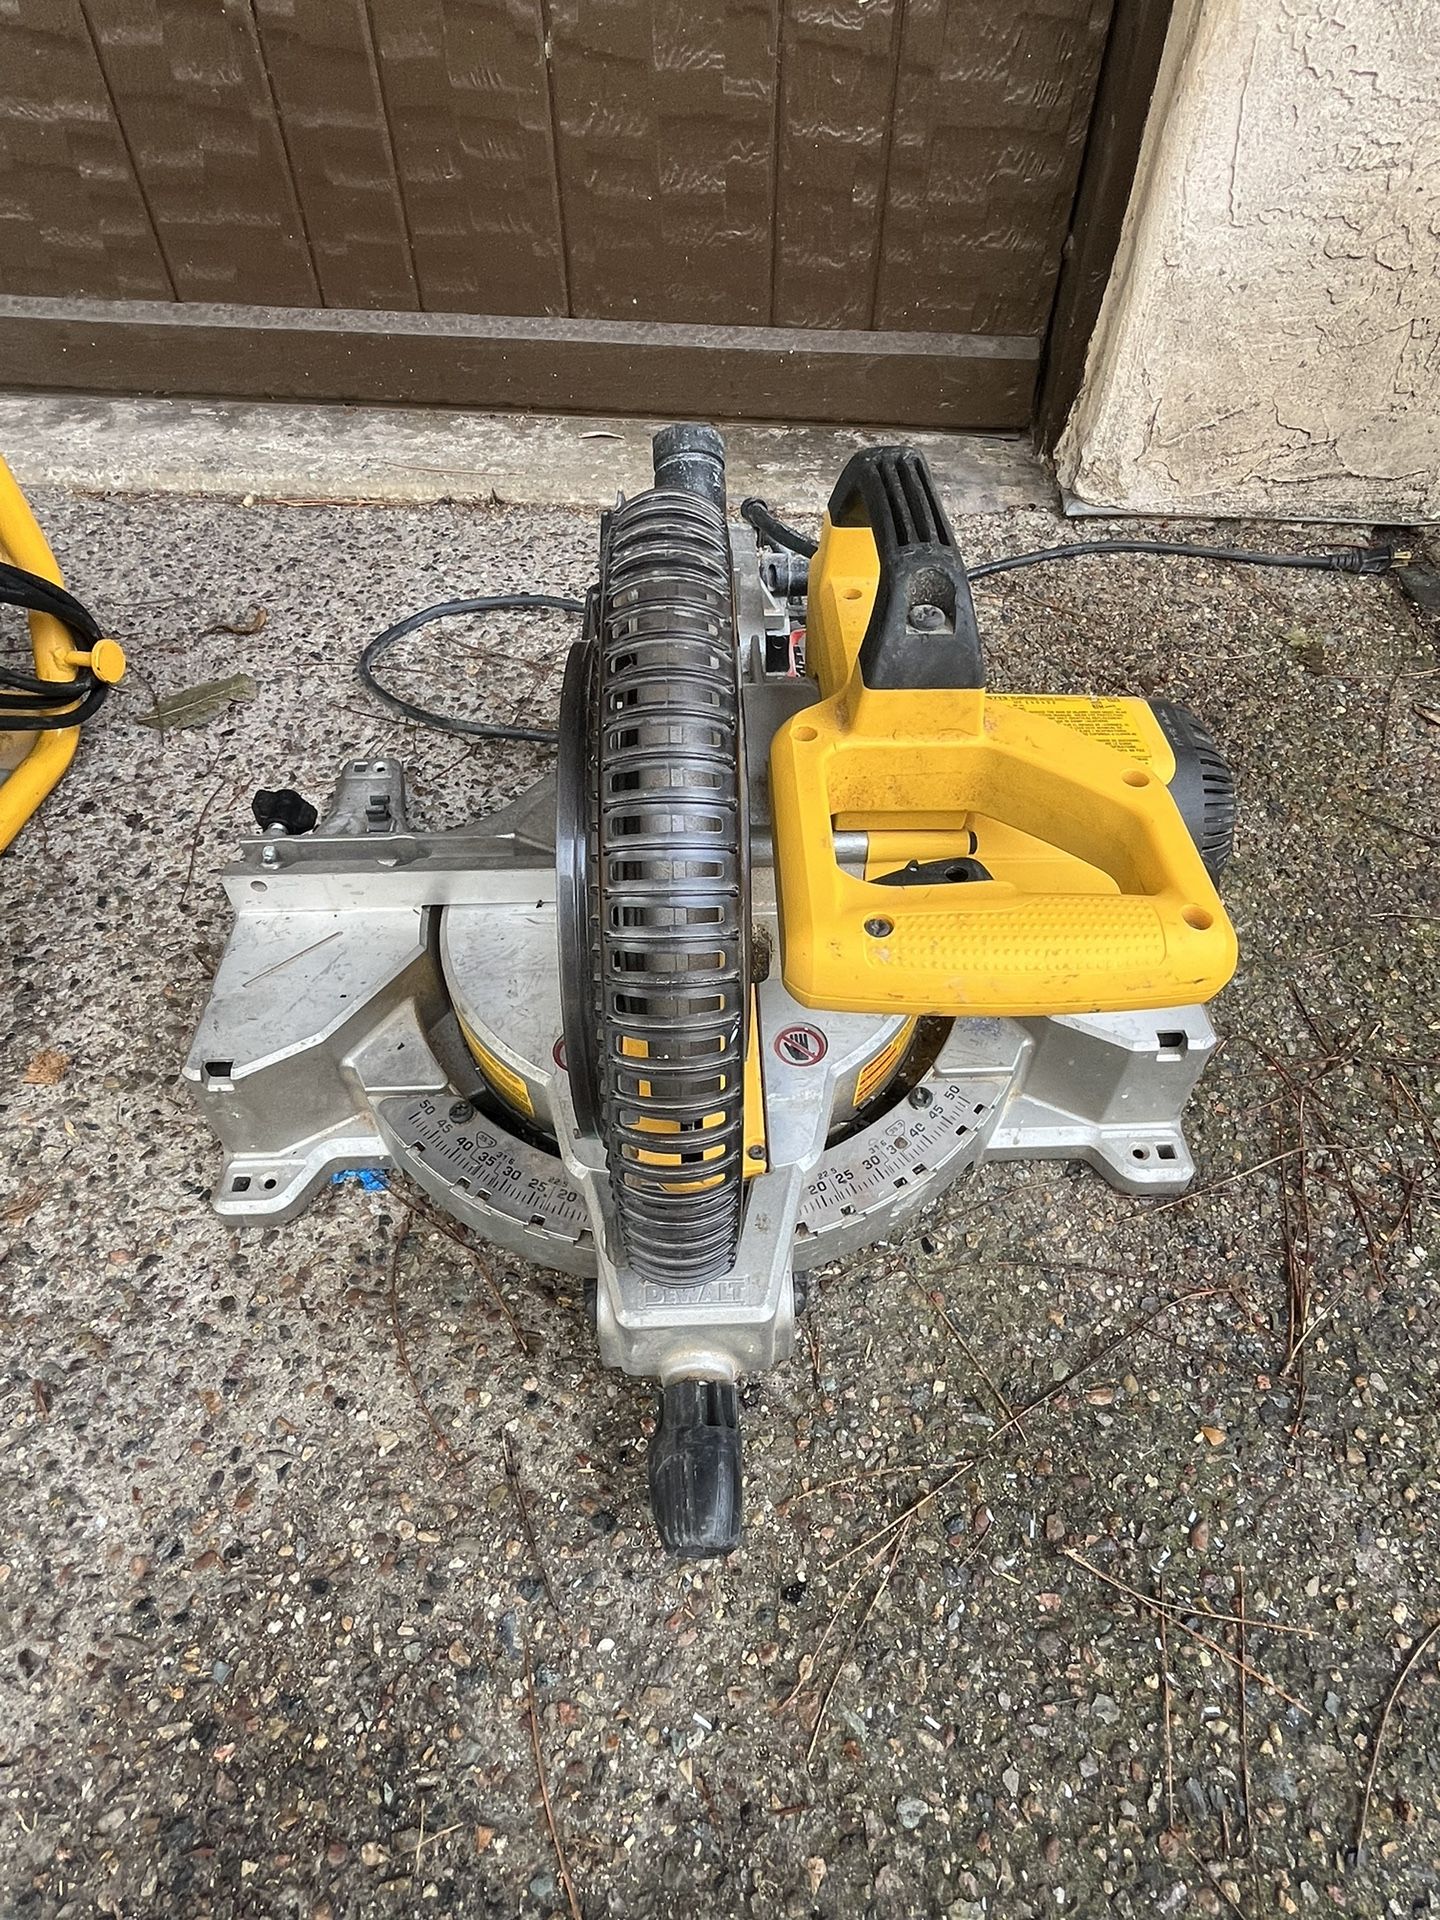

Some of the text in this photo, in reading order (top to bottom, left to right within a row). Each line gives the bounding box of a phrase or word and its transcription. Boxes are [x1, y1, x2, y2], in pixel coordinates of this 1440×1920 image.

[944, 1085, 960, 1101] 50
[419, 1100, 435, 1116] 50
[928, 1104, 944, 1120] 45
[437, 1119, 453, 1134] 45
[456, 1136, 474, 1152] 40
[478, 1152, 497, 1167] 35
[862, 1155, 881, 1170] 30
[503, 1166, 522, 1180] 30
[835, 1169, 854, 1184] 25
[528, 1178, 547, 1192] 25
[808, 1181, 827, 1195] 20
[557, 1189, 577, 1202] 20
[645, 1282, 746, 1304] DEWALT
